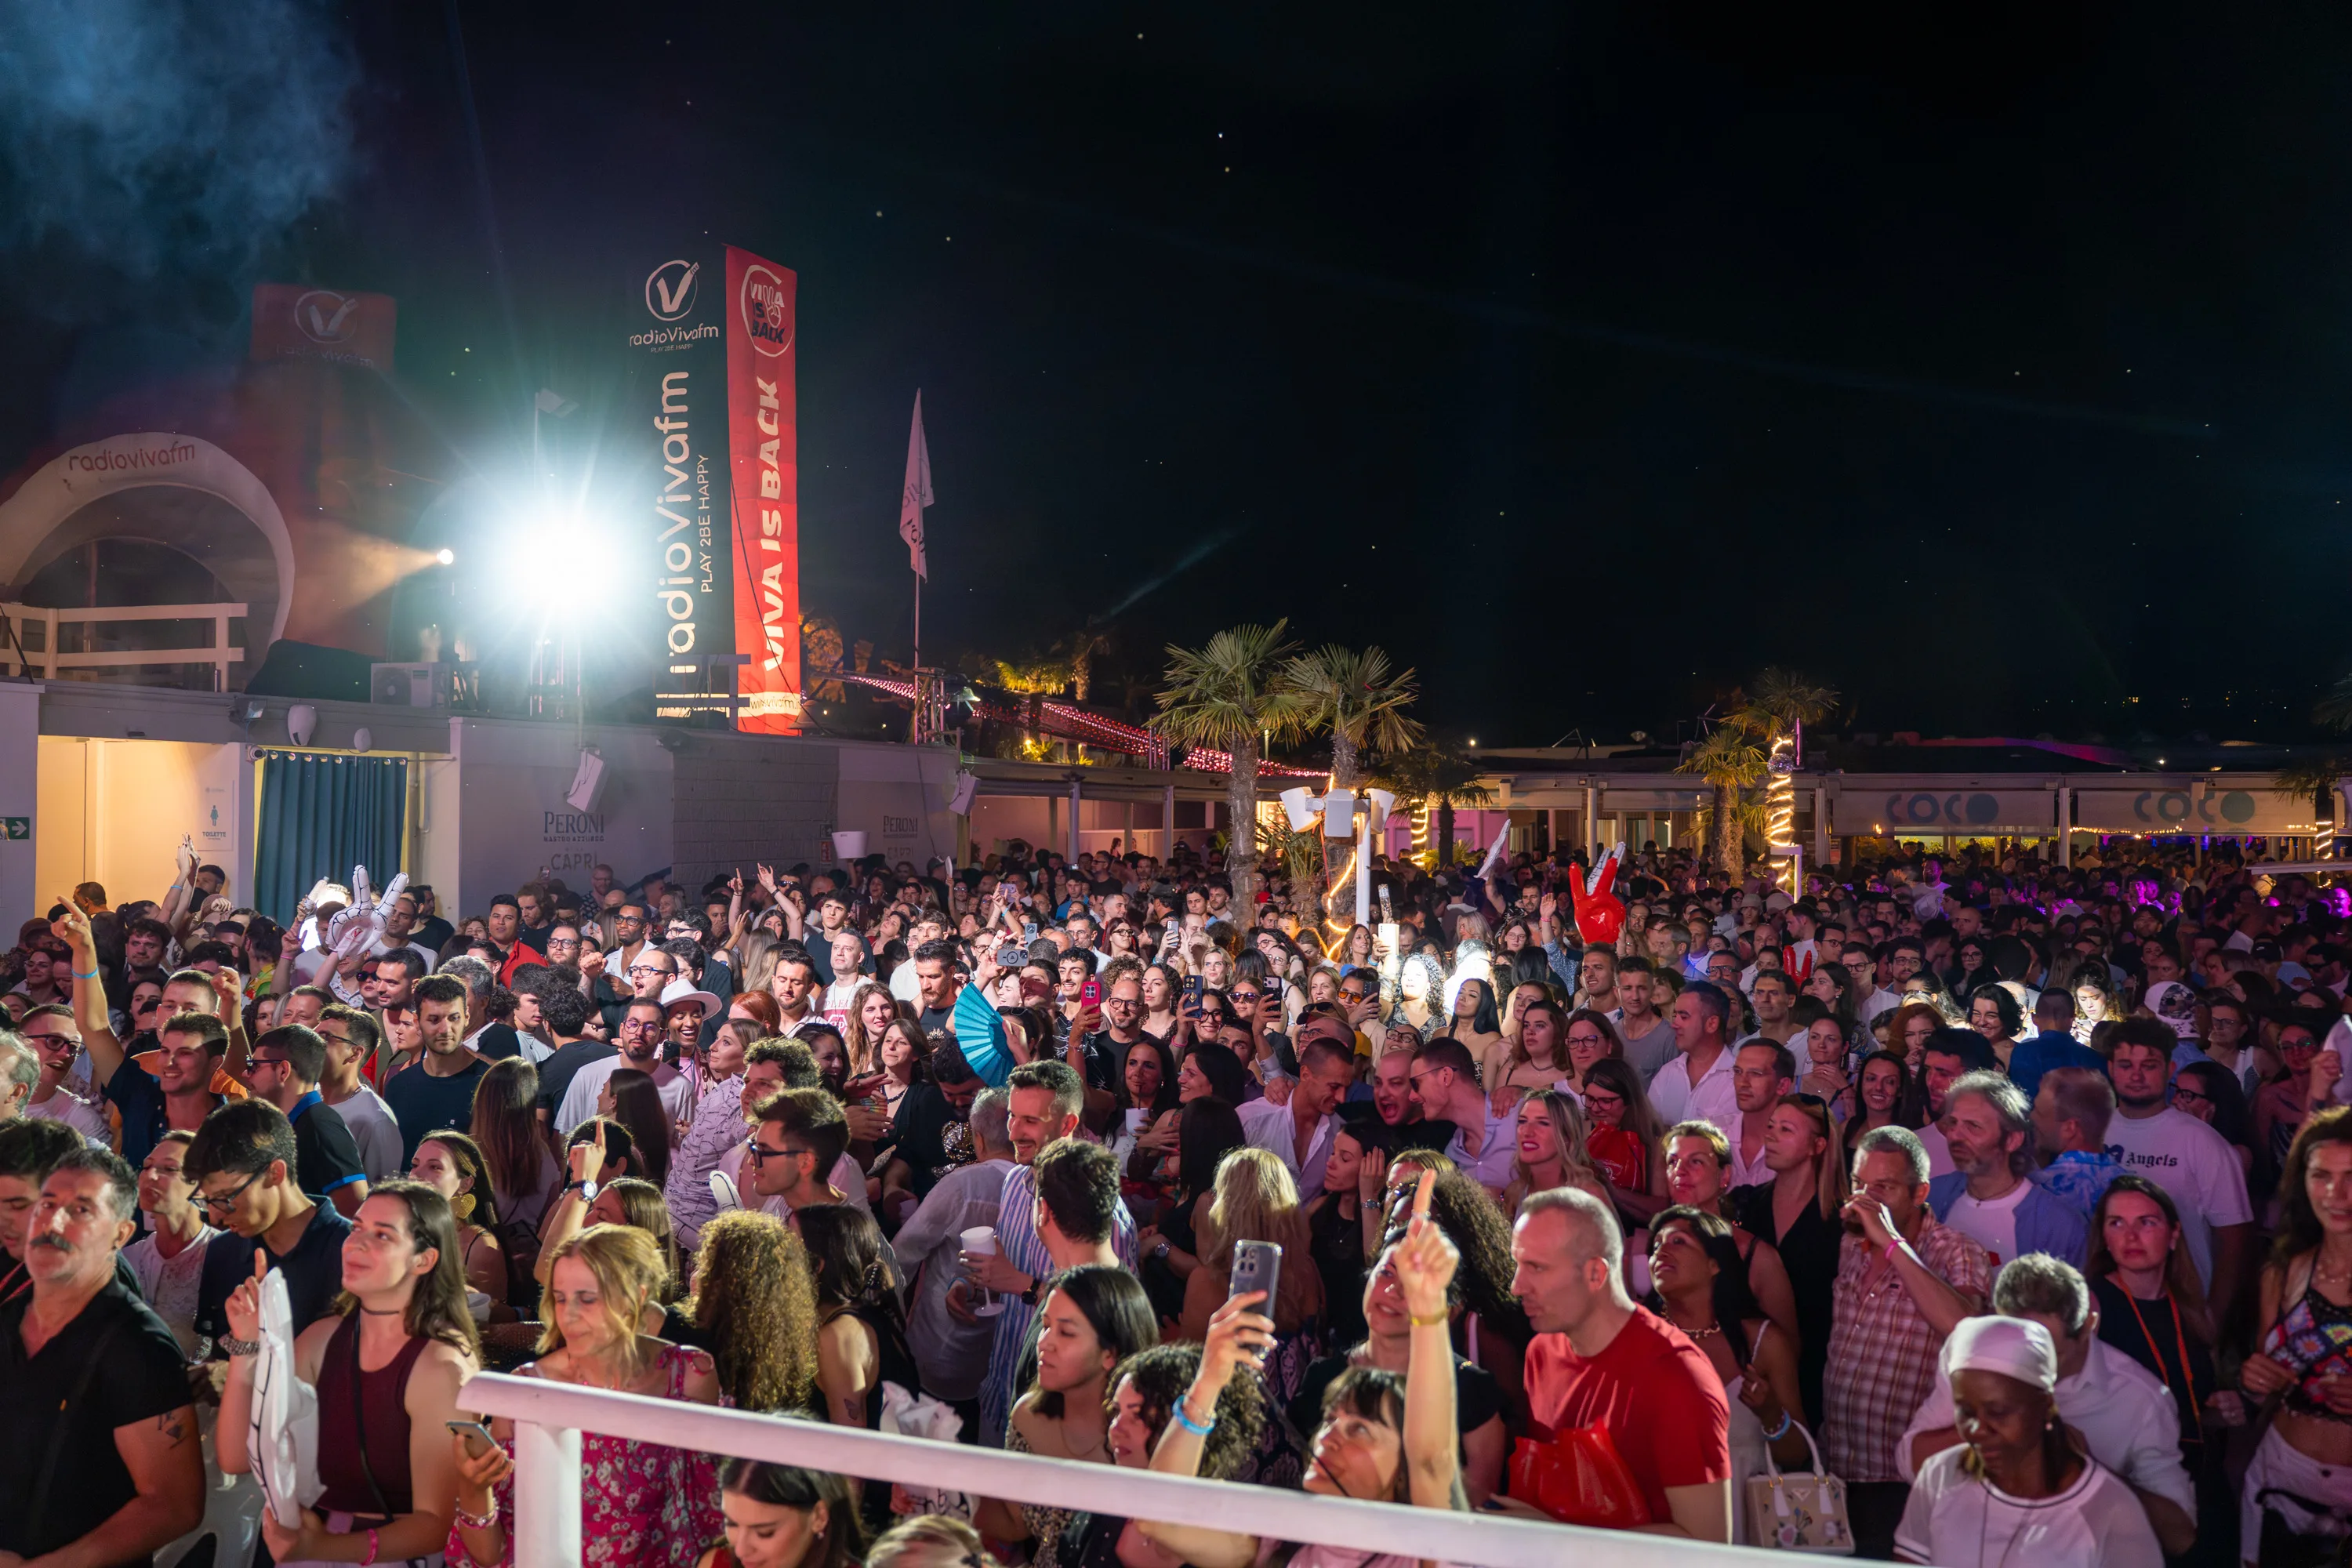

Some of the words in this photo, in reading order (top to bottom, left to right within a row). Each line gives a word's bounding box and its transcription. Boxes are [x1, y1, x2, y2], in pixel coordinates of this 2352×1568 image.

[630, 322, 719, 347] radioVivafm
[752, 320, 786, 344] BACK
[756, 375, 782, 499] BACK
[69, 441, 195, 472] radiovivafm
[698, 454, 710, 510] HAPPY
[699, 514, 712, 546] 2BE
[760, 510, 782, 554] IS
[699, 552, 713, 593] PLAY
[761, 561, 785, 672] VIVA
[544, 811, 604, 833] PERONI
[883, 815, 918, 833] PERONI
[551, 850, 597, 870] CAPRI
[2125, 1152, 2178, 1168] Angels
